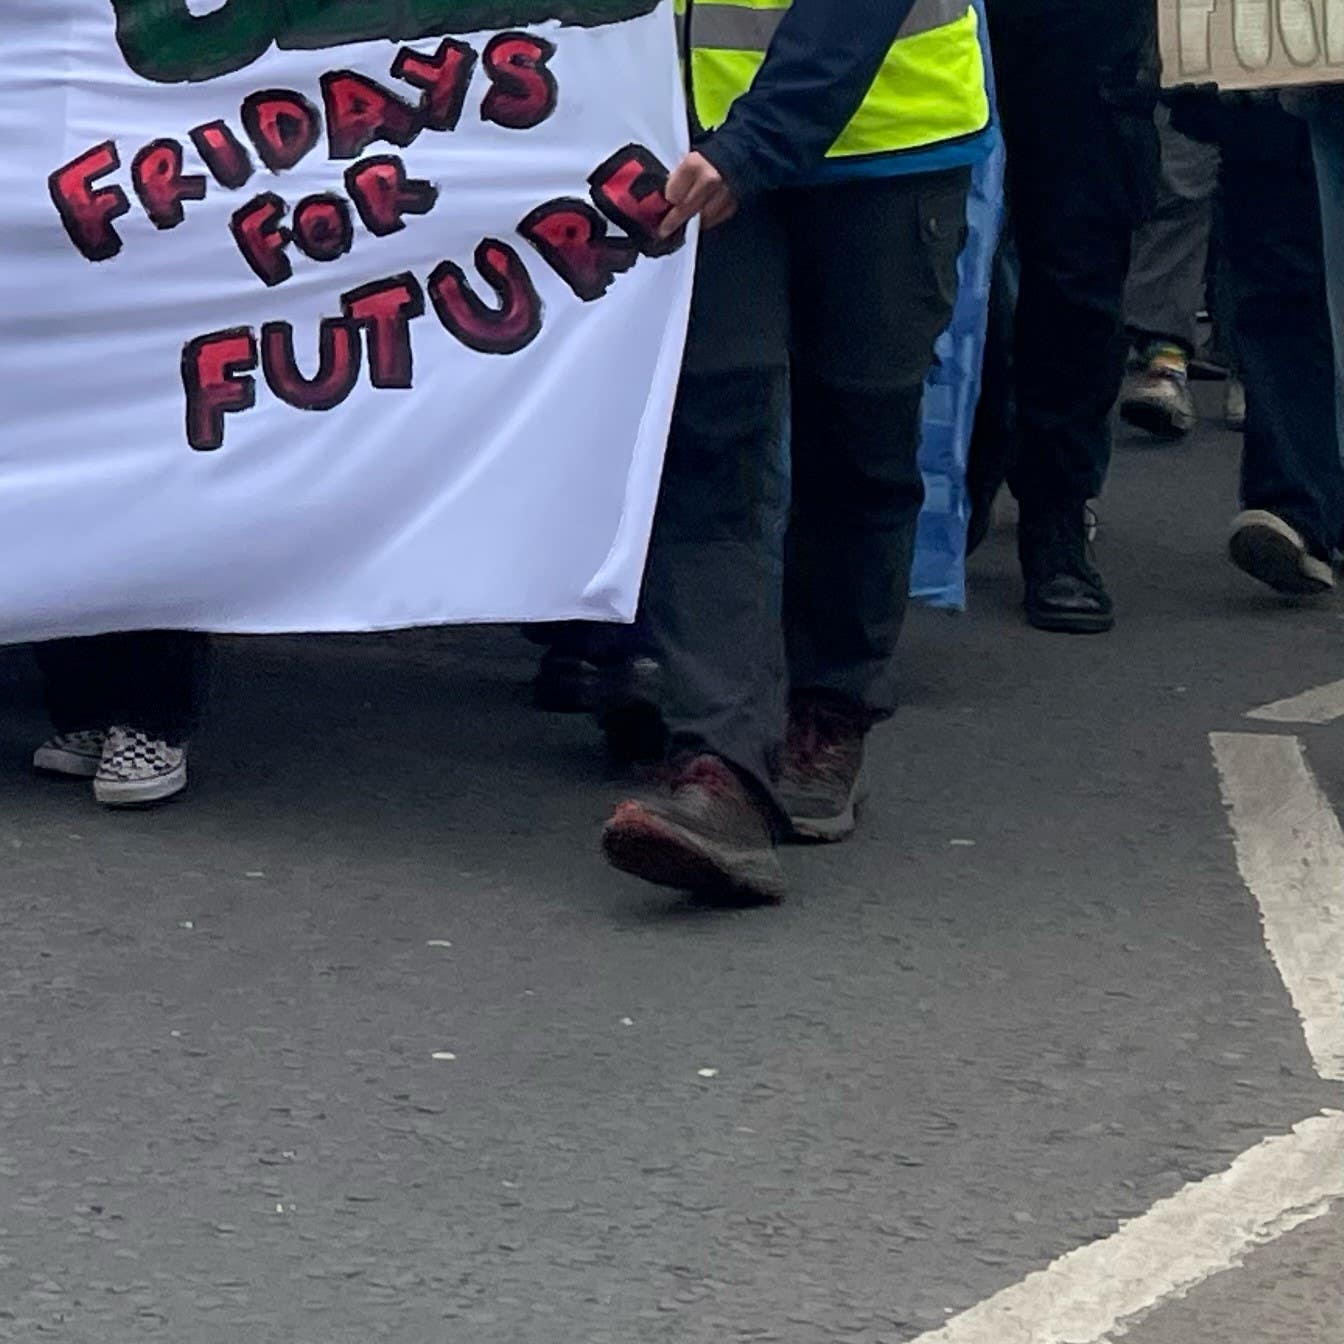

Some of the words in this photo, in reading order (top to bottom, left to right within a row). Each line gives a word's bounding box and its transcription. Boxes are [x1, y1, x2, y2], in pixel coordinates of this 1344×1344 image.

[47, 31, 558, 262] FRIDAYS
[230, 154, 439, 288] FOR
[180, 142, 689, 452] FUTURE
